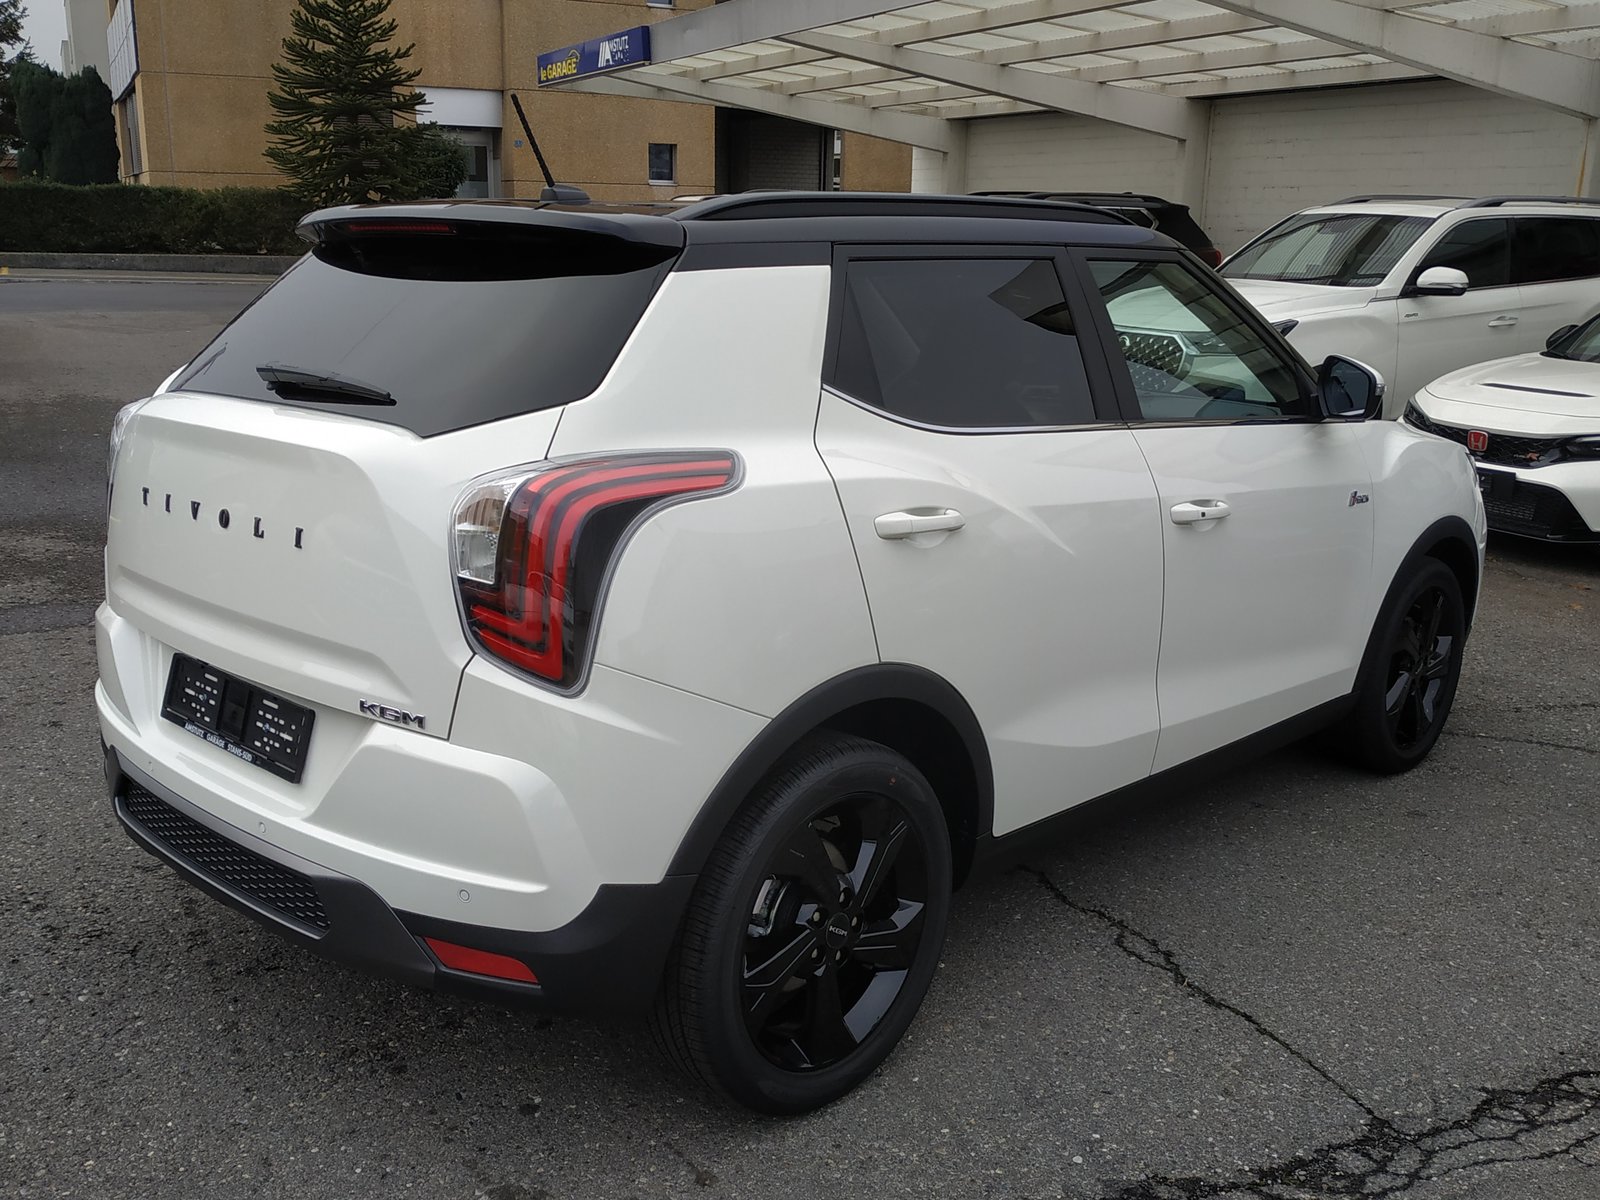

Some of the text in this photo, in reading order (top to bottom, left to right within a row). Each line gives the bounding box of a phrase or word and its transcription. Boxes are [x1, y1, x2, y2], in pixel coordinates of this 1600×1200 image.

[547, 58, 577, 79] GARAGE
[142, 486, 304, 549] TIVOLI
[359, 698, 427, 729] KGM
[184, 722, 204, 738] AMSTUTZ
[206, 733, 225, 748] GARAGE
[829, 925, 848, 936] KGM
